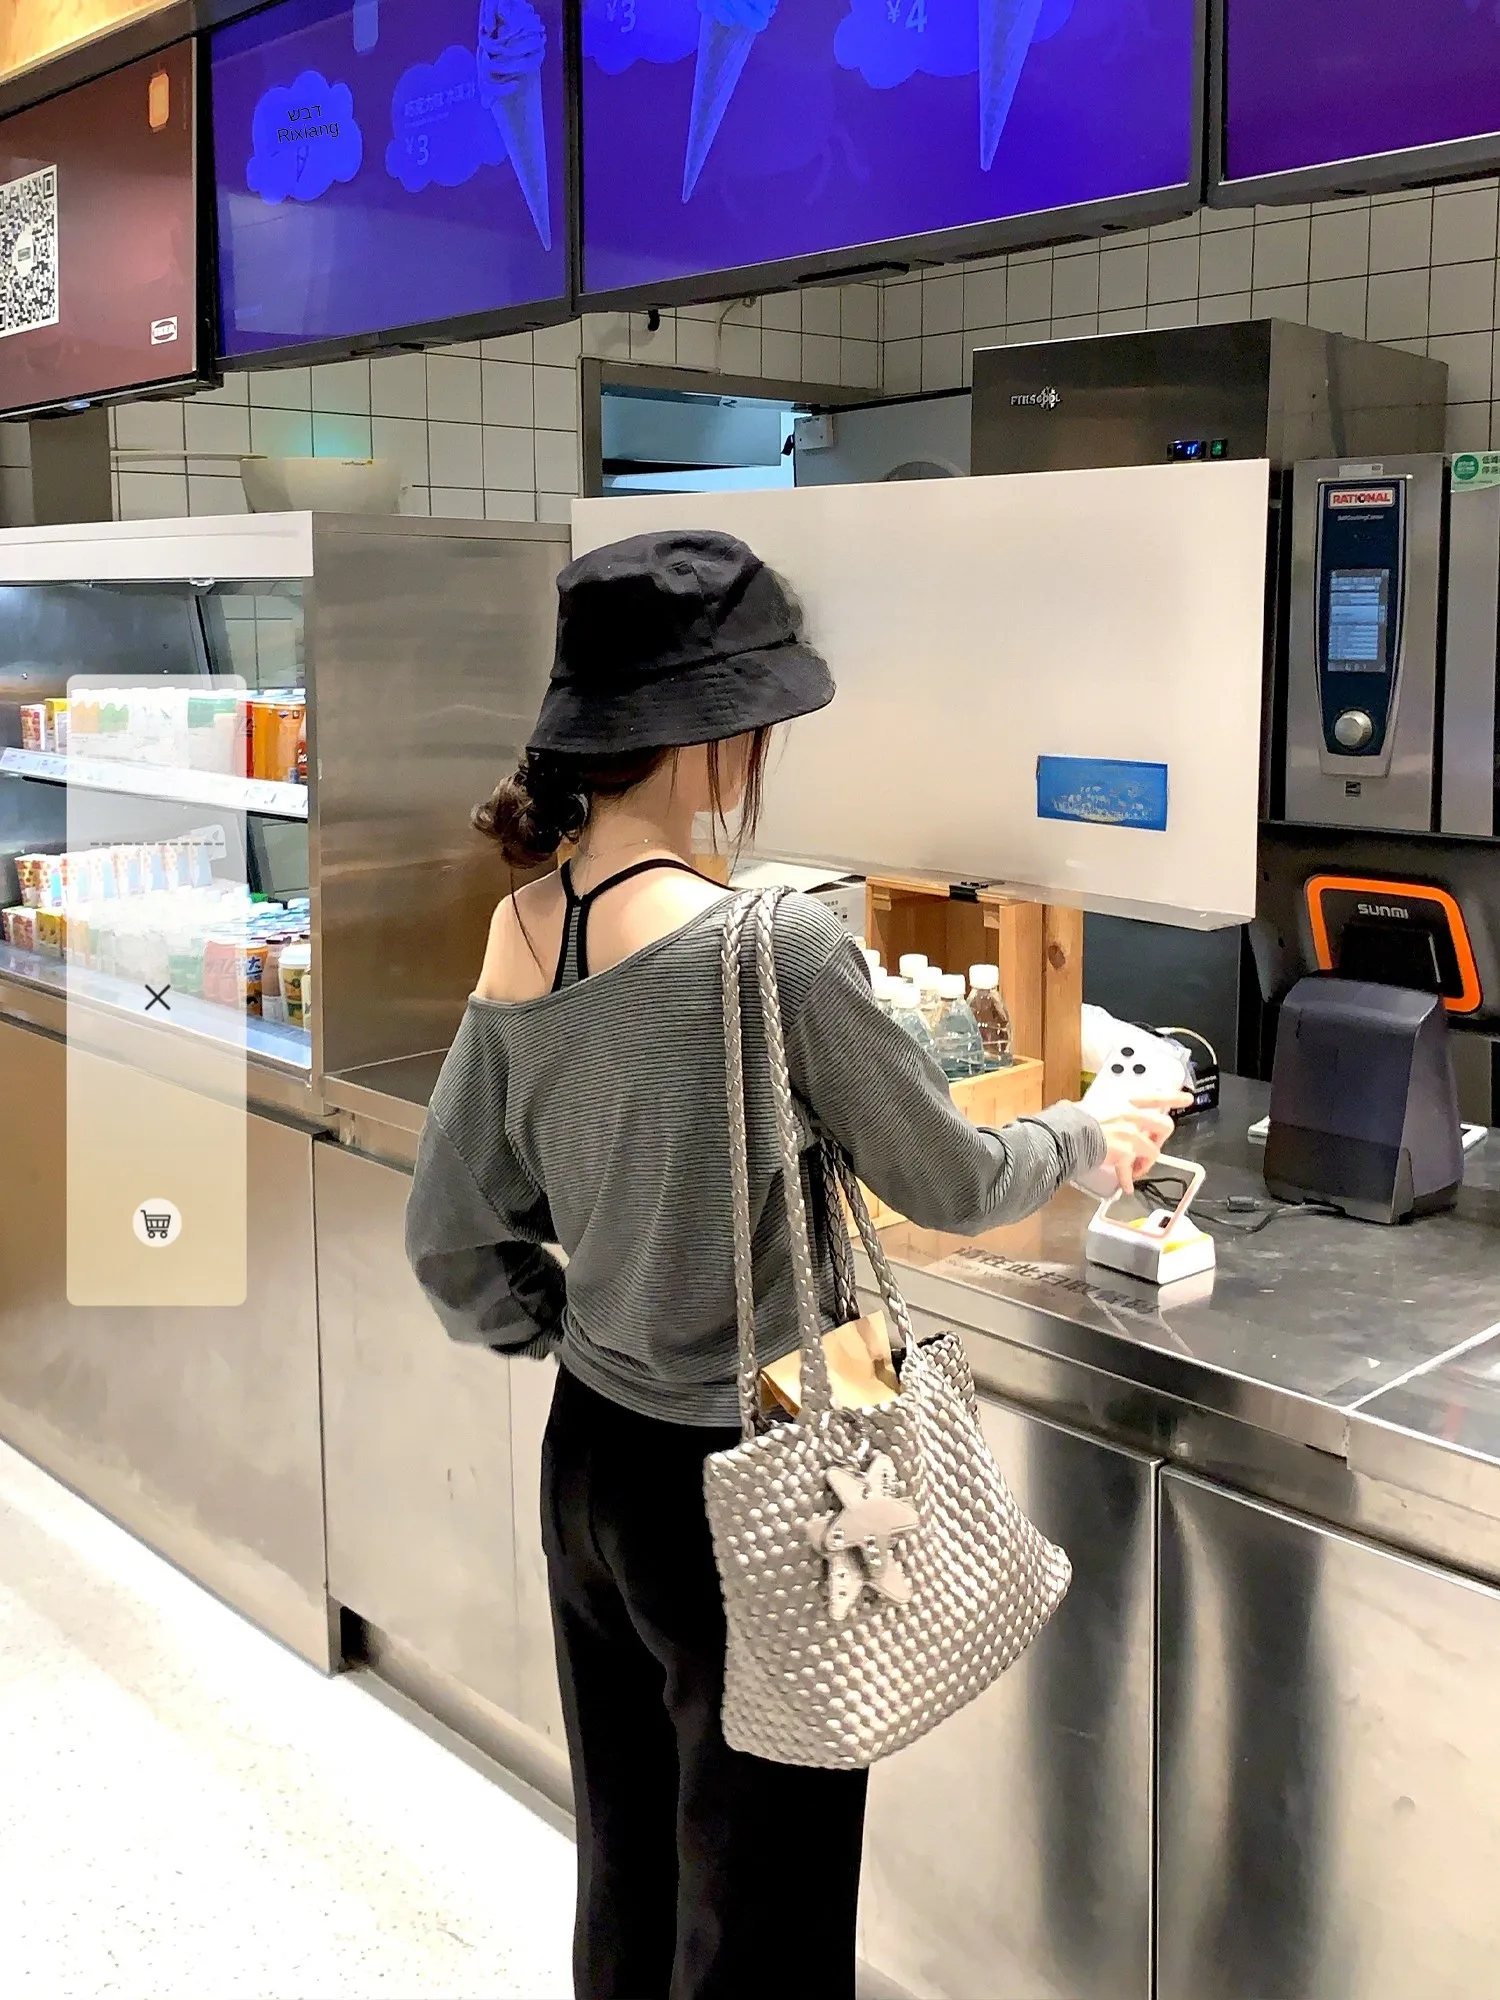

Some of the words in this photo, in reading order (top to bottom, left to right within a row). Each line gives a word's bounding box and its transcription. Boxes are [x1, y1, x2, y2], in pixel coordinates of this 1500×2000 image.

[287, 105, 321, 122] דבש
[277, 122, 340, 143] Rixiang
[1332, 492, 1391, 504] RATIONAL
